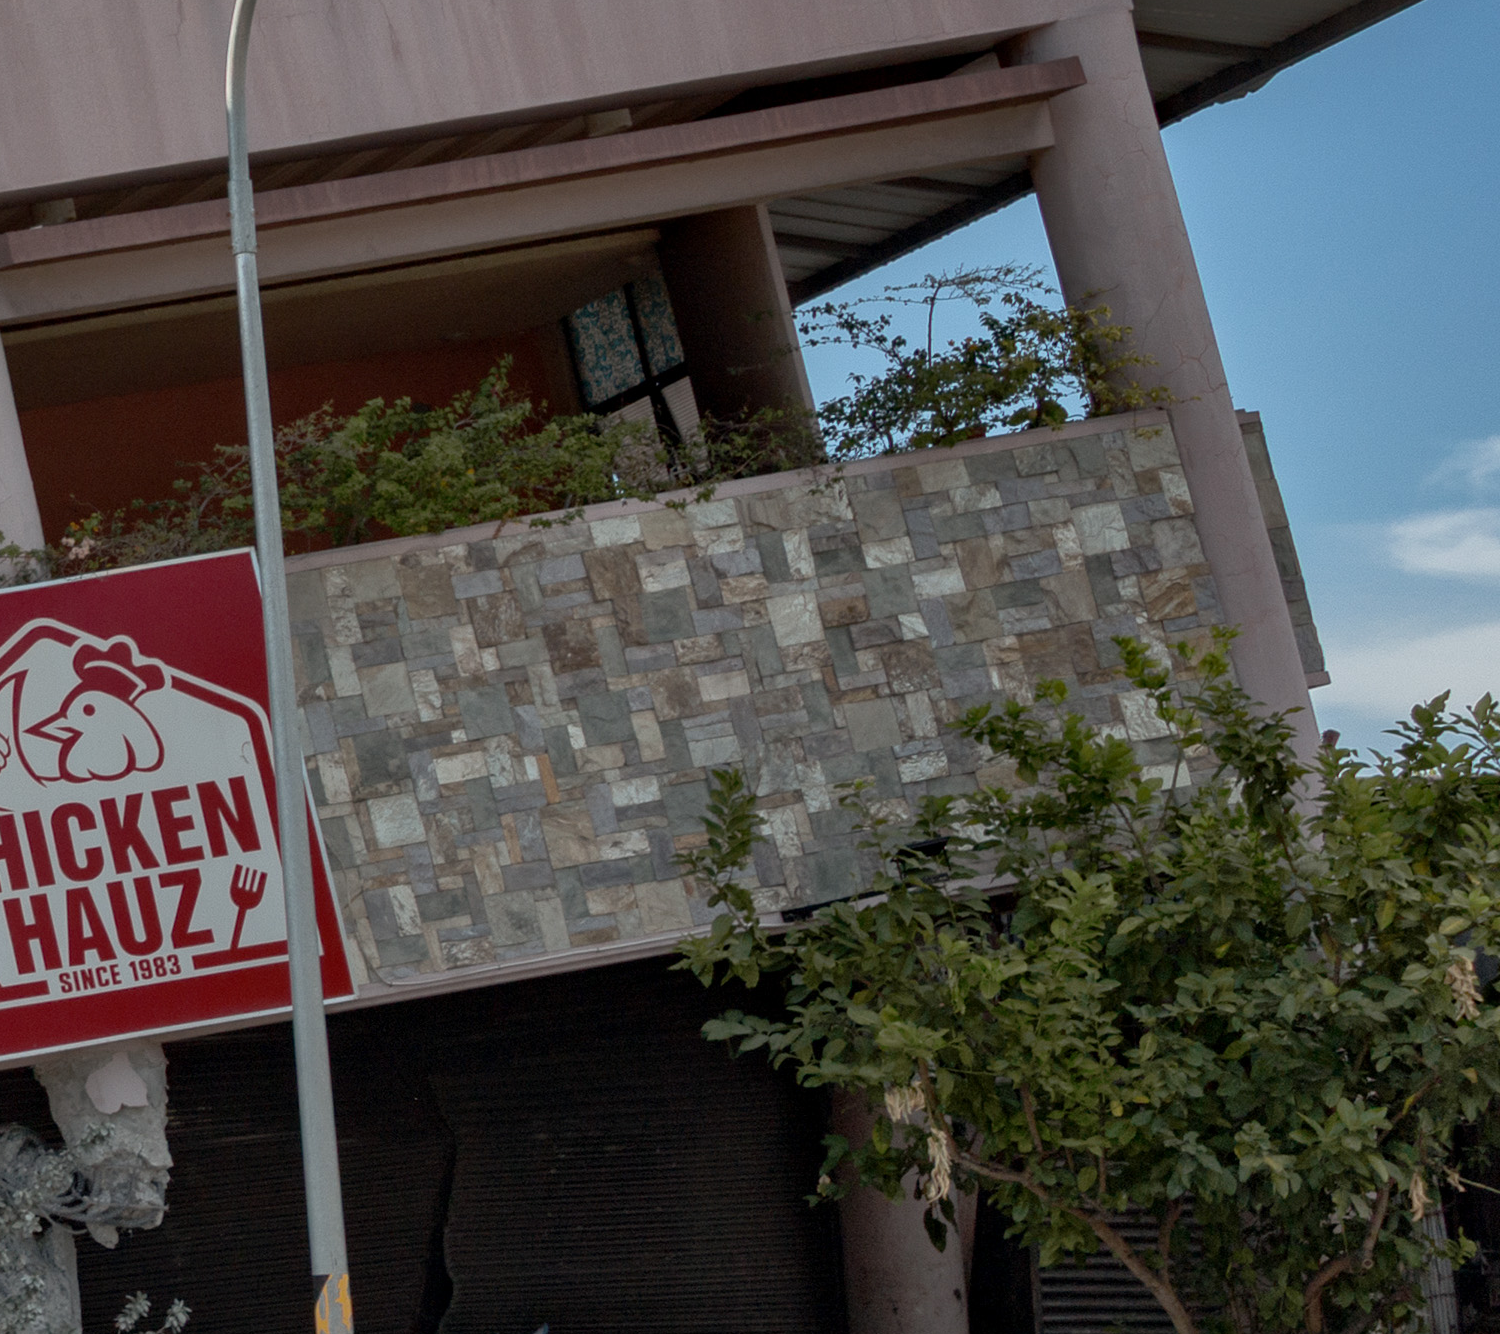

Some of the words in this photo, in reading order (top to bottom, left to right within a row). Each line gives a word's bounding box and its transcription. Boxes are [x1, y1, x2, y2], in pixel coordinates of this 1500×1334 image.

[2, 868, 215, 976] HAUZ
[58, 963, 123, 994] SINCE
[130, 954, 183, 983] 1983
